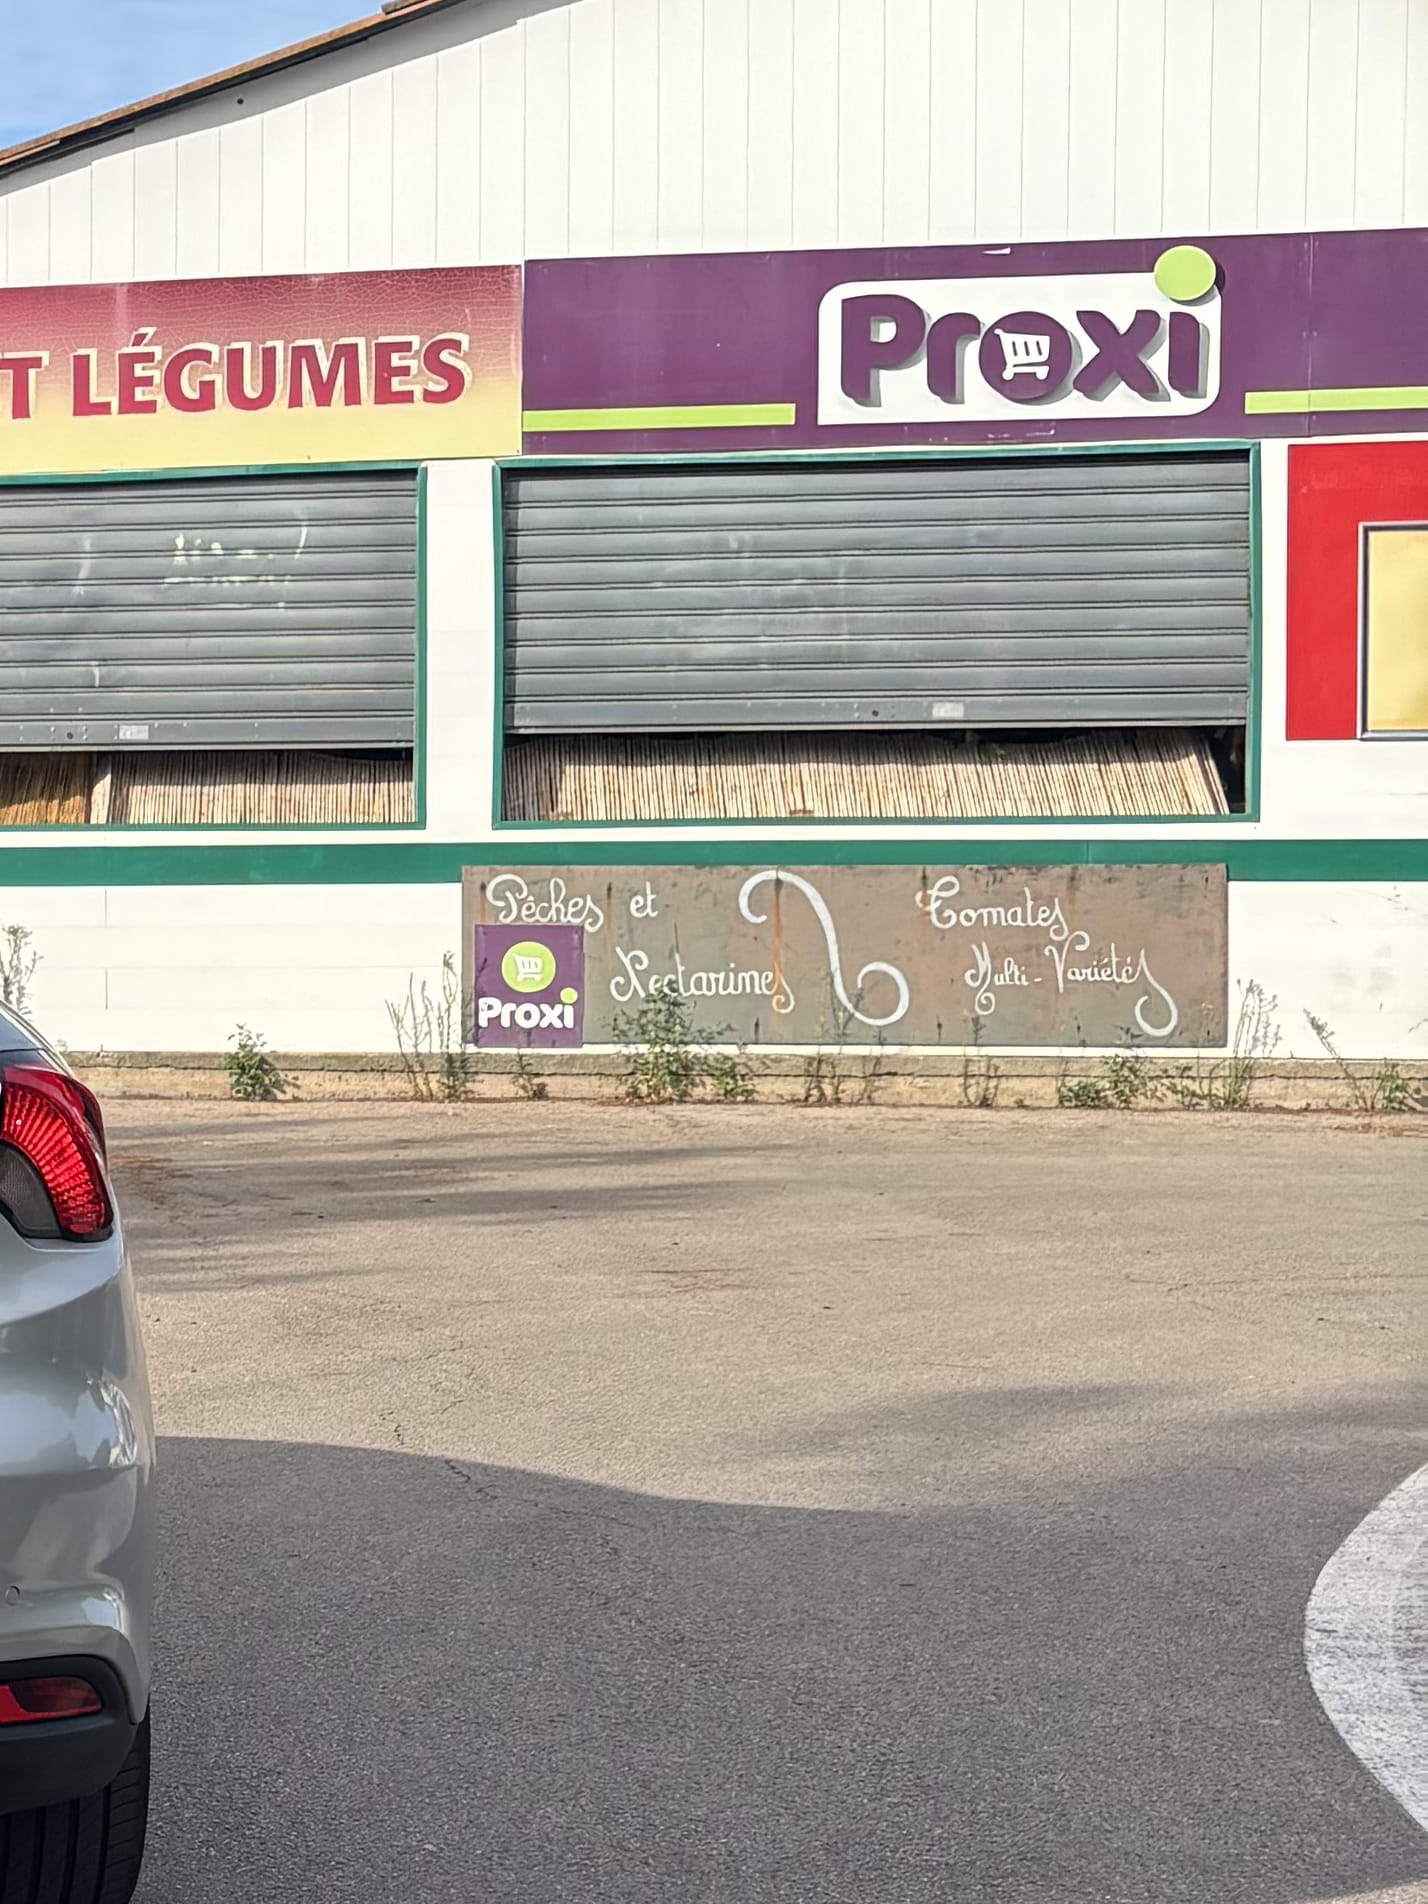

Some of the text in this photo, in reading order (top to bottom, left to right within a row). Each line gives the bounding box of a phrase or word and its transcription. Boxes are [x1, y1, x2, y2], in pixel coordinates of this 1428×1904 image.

[841, 245, 1219, 408] Proxi
[71, 326, 472, 417] LÉGUMES
[486, 874, 658, 933] Pêches et
[915, 876, 1069, 941] Tomates
[477, 987, 578, 1029] Proxi
[610, 947, 794, 1014] Nectarines
